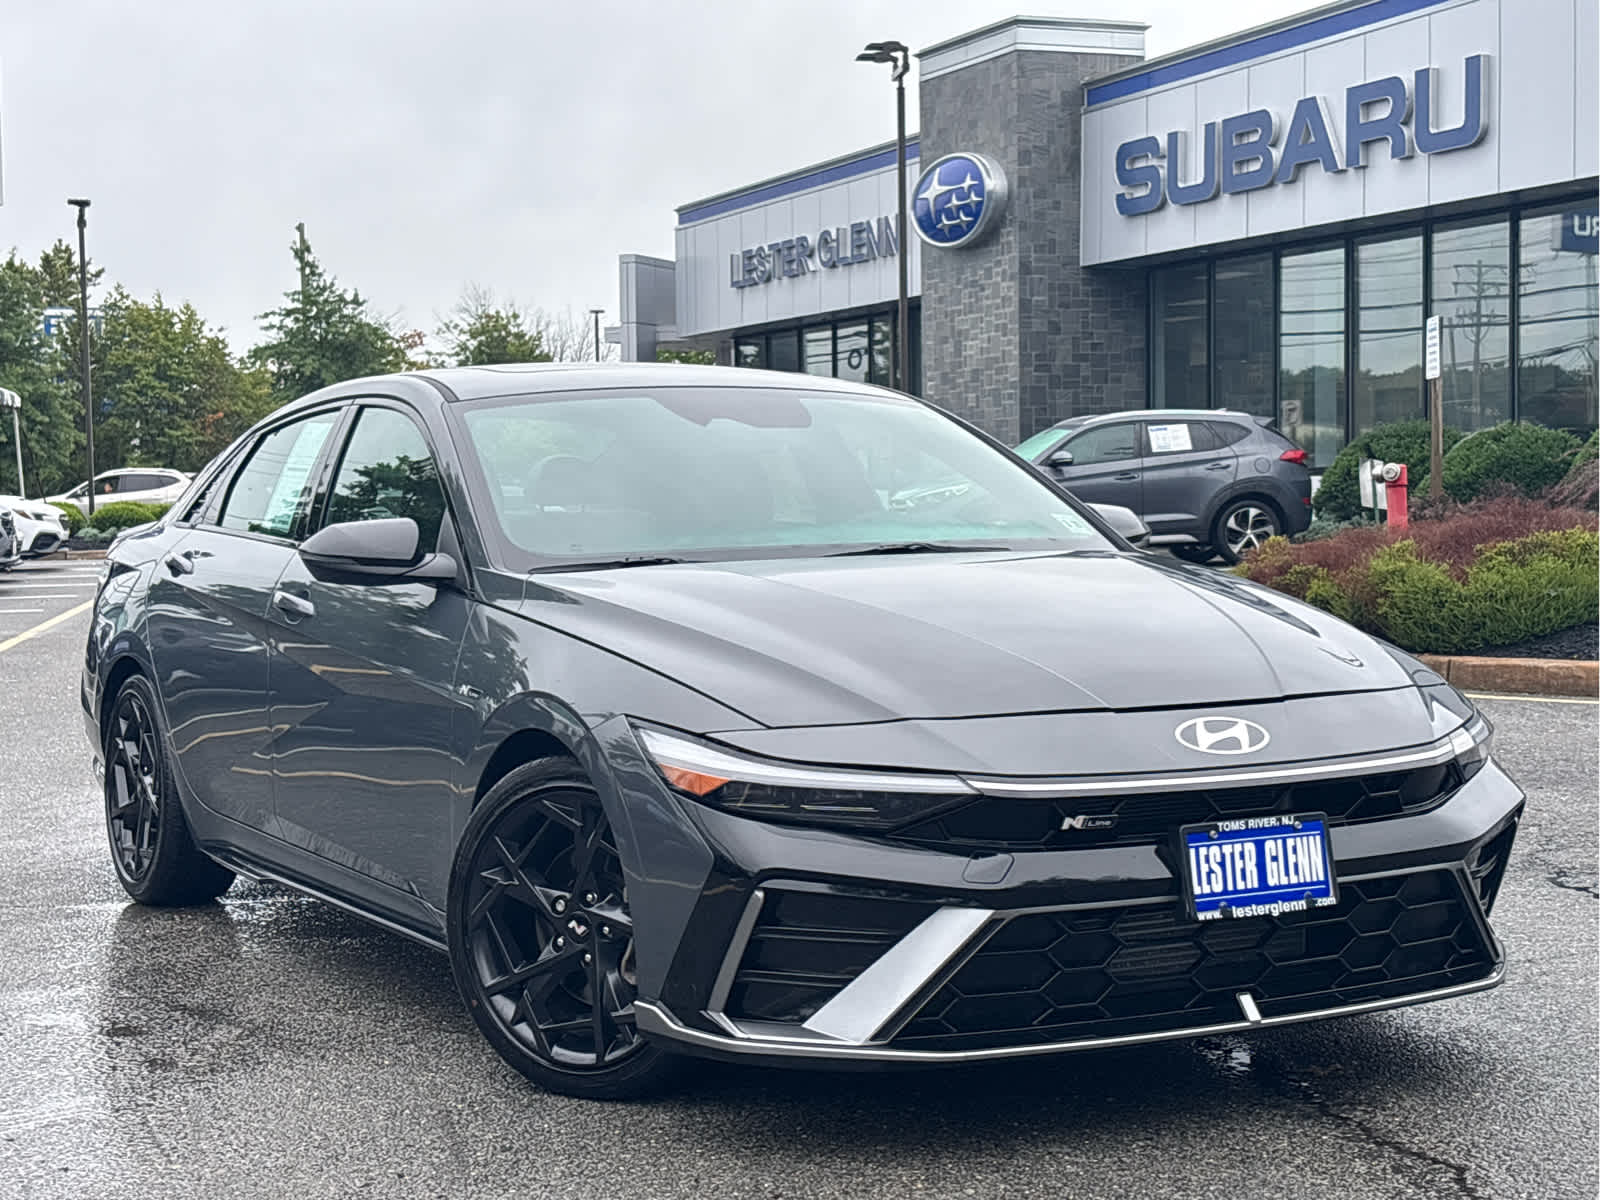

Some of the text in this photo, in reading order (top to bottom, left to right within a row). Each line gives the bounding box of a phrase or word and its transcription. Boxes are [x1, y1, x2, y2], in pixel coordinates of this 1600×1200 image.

[1115, 51, 1493, 217] SUBARU
[730, 213, 899, 289] LESTER GLENN
[1217, 820, 1246, 832] TOMS
[1281, 815, 1295, 825] NJ
[1189, 835, 1326, 895] LESTER GLENN
[1231, 900, 1307, 918] lesterglenn
